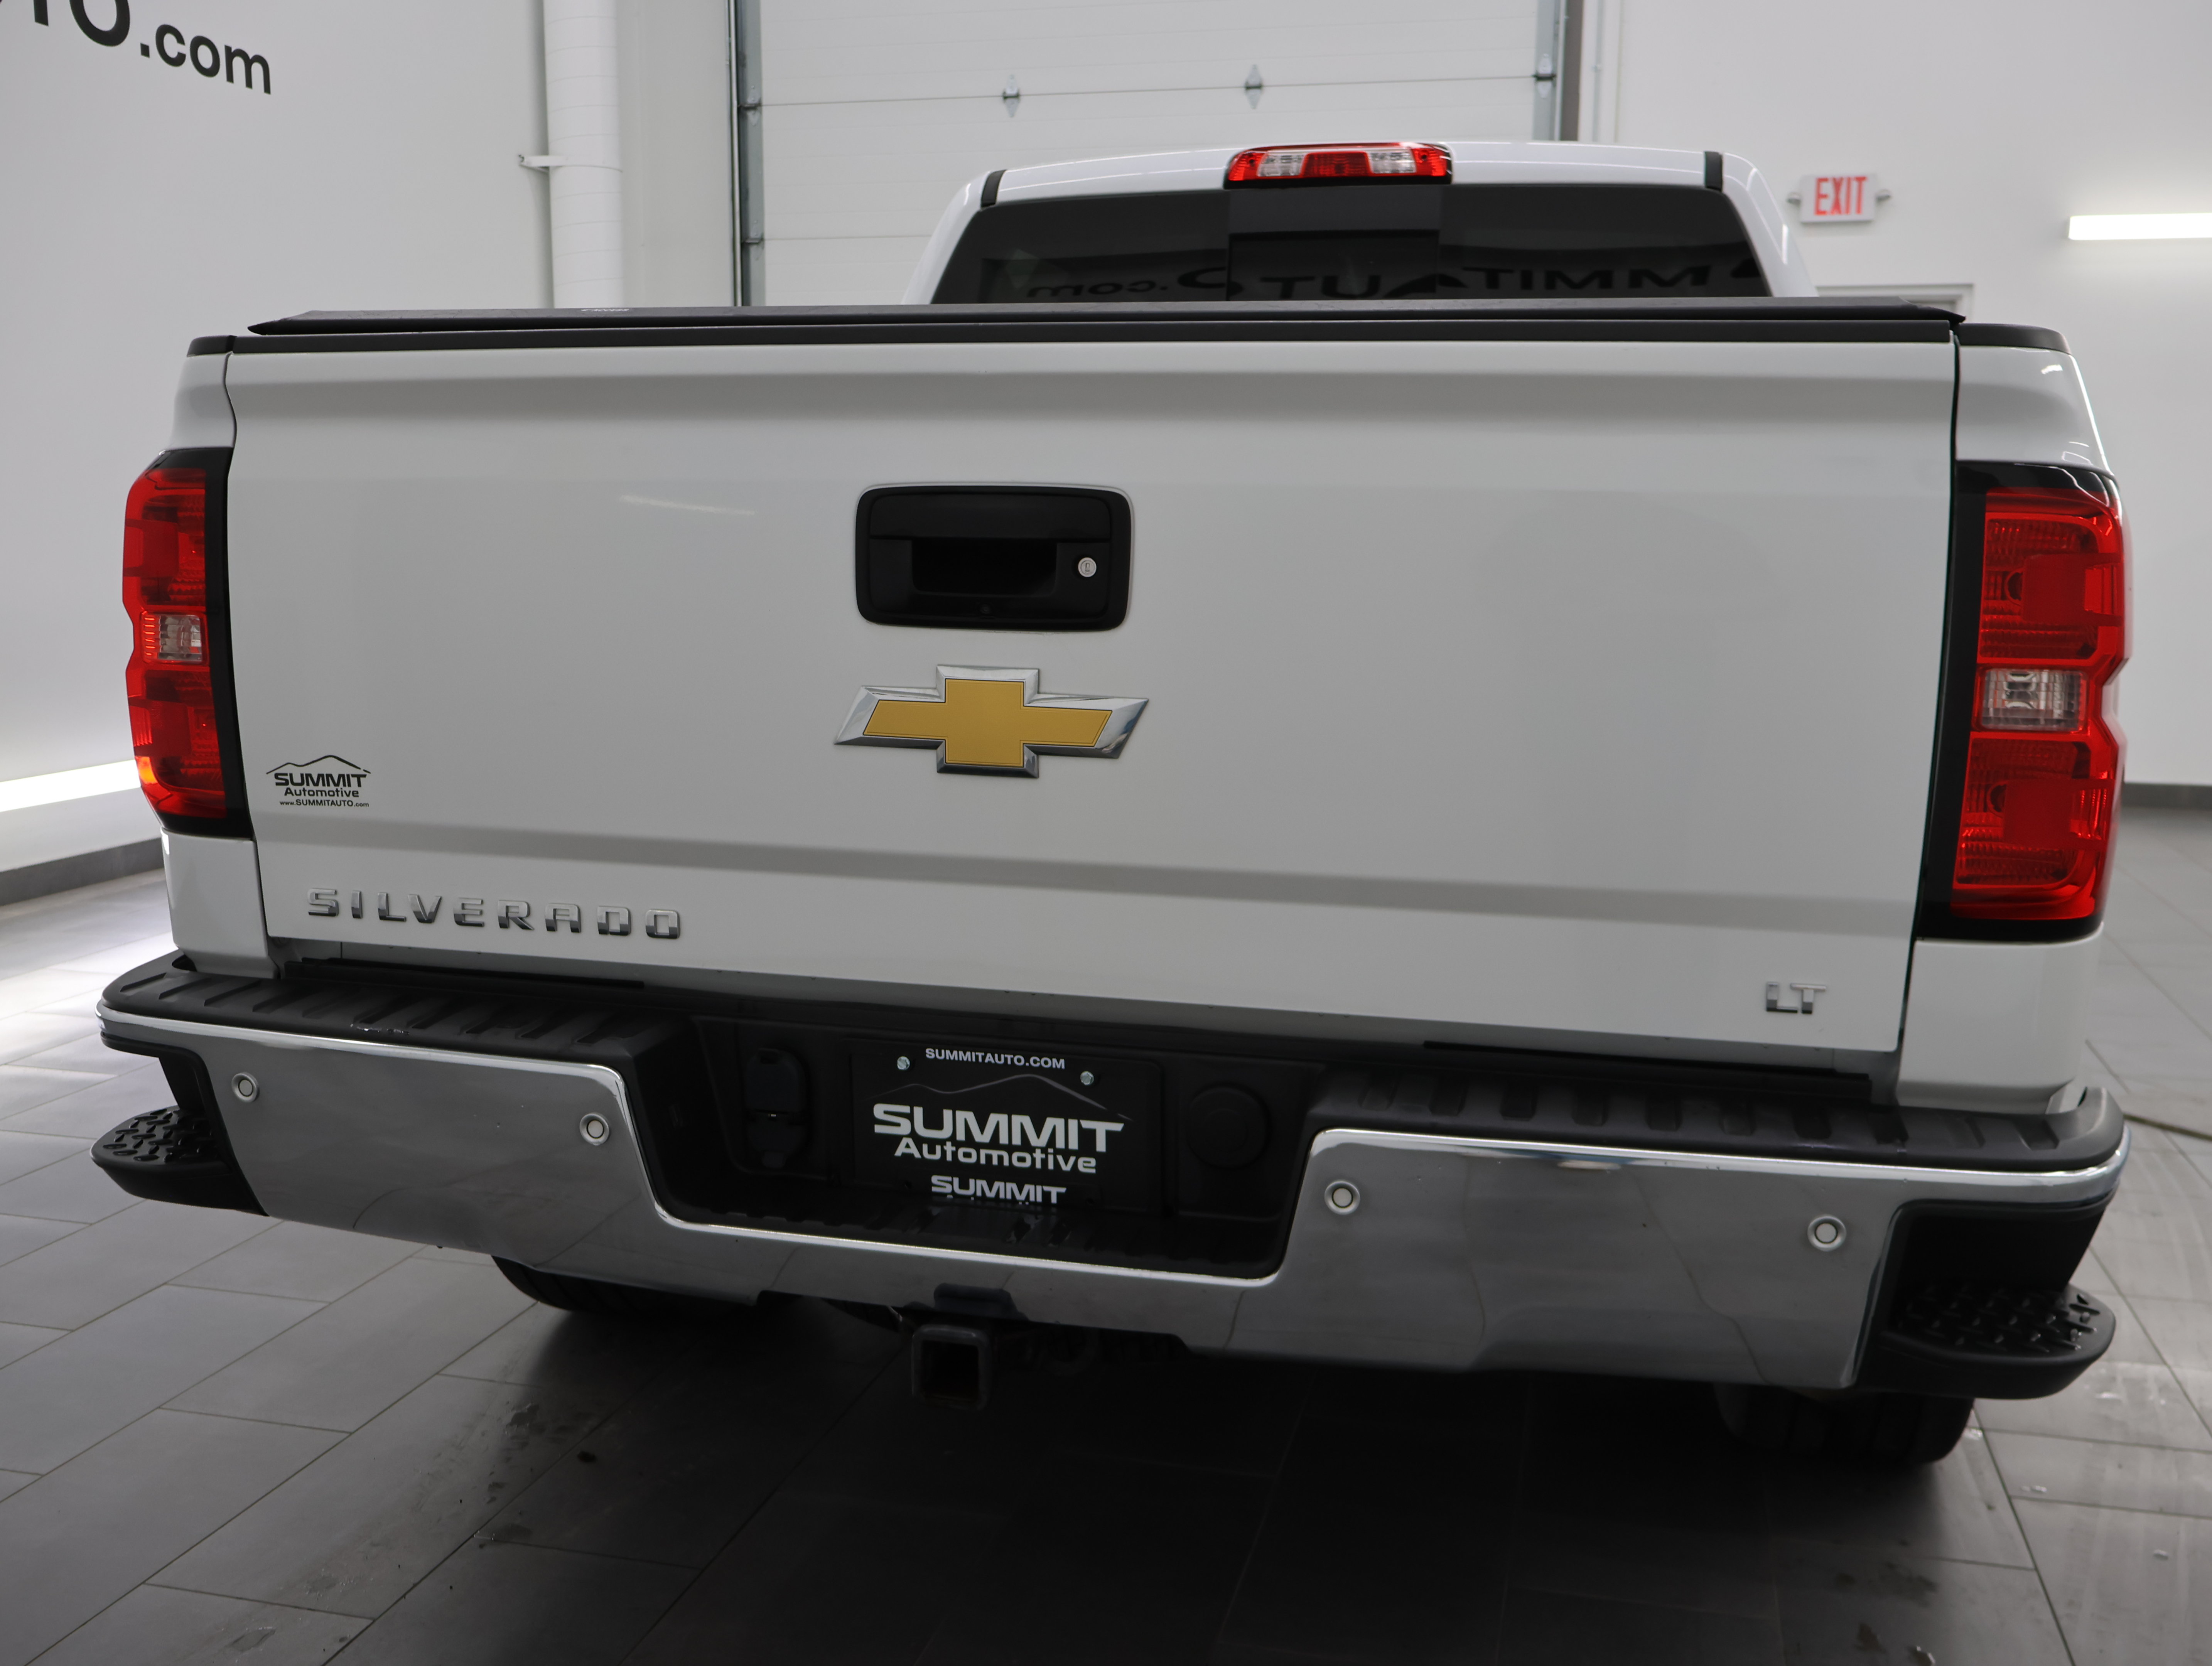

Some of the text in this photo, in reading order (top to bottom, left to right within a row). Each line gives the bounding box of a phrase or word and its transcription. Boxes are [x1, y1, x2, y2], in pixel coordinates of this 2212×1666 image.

[1815, 176, 1867, 215] EXIT
[274, 772, 367, 787] SUMMIT
[284, 787, 359, 798] Automotive
[308, 888, 680, 939] SILVERADO
[1766, 982, 1826, 1014] LT
[925, 1047, 1065, 1069] SUMMITAUTO.COM
[873, 1103, 1124, 1153] SUMMIT
[894, 1137, 1096, 1174] Automotive
[931, 1174, 1066, 1204] SUMMIT
